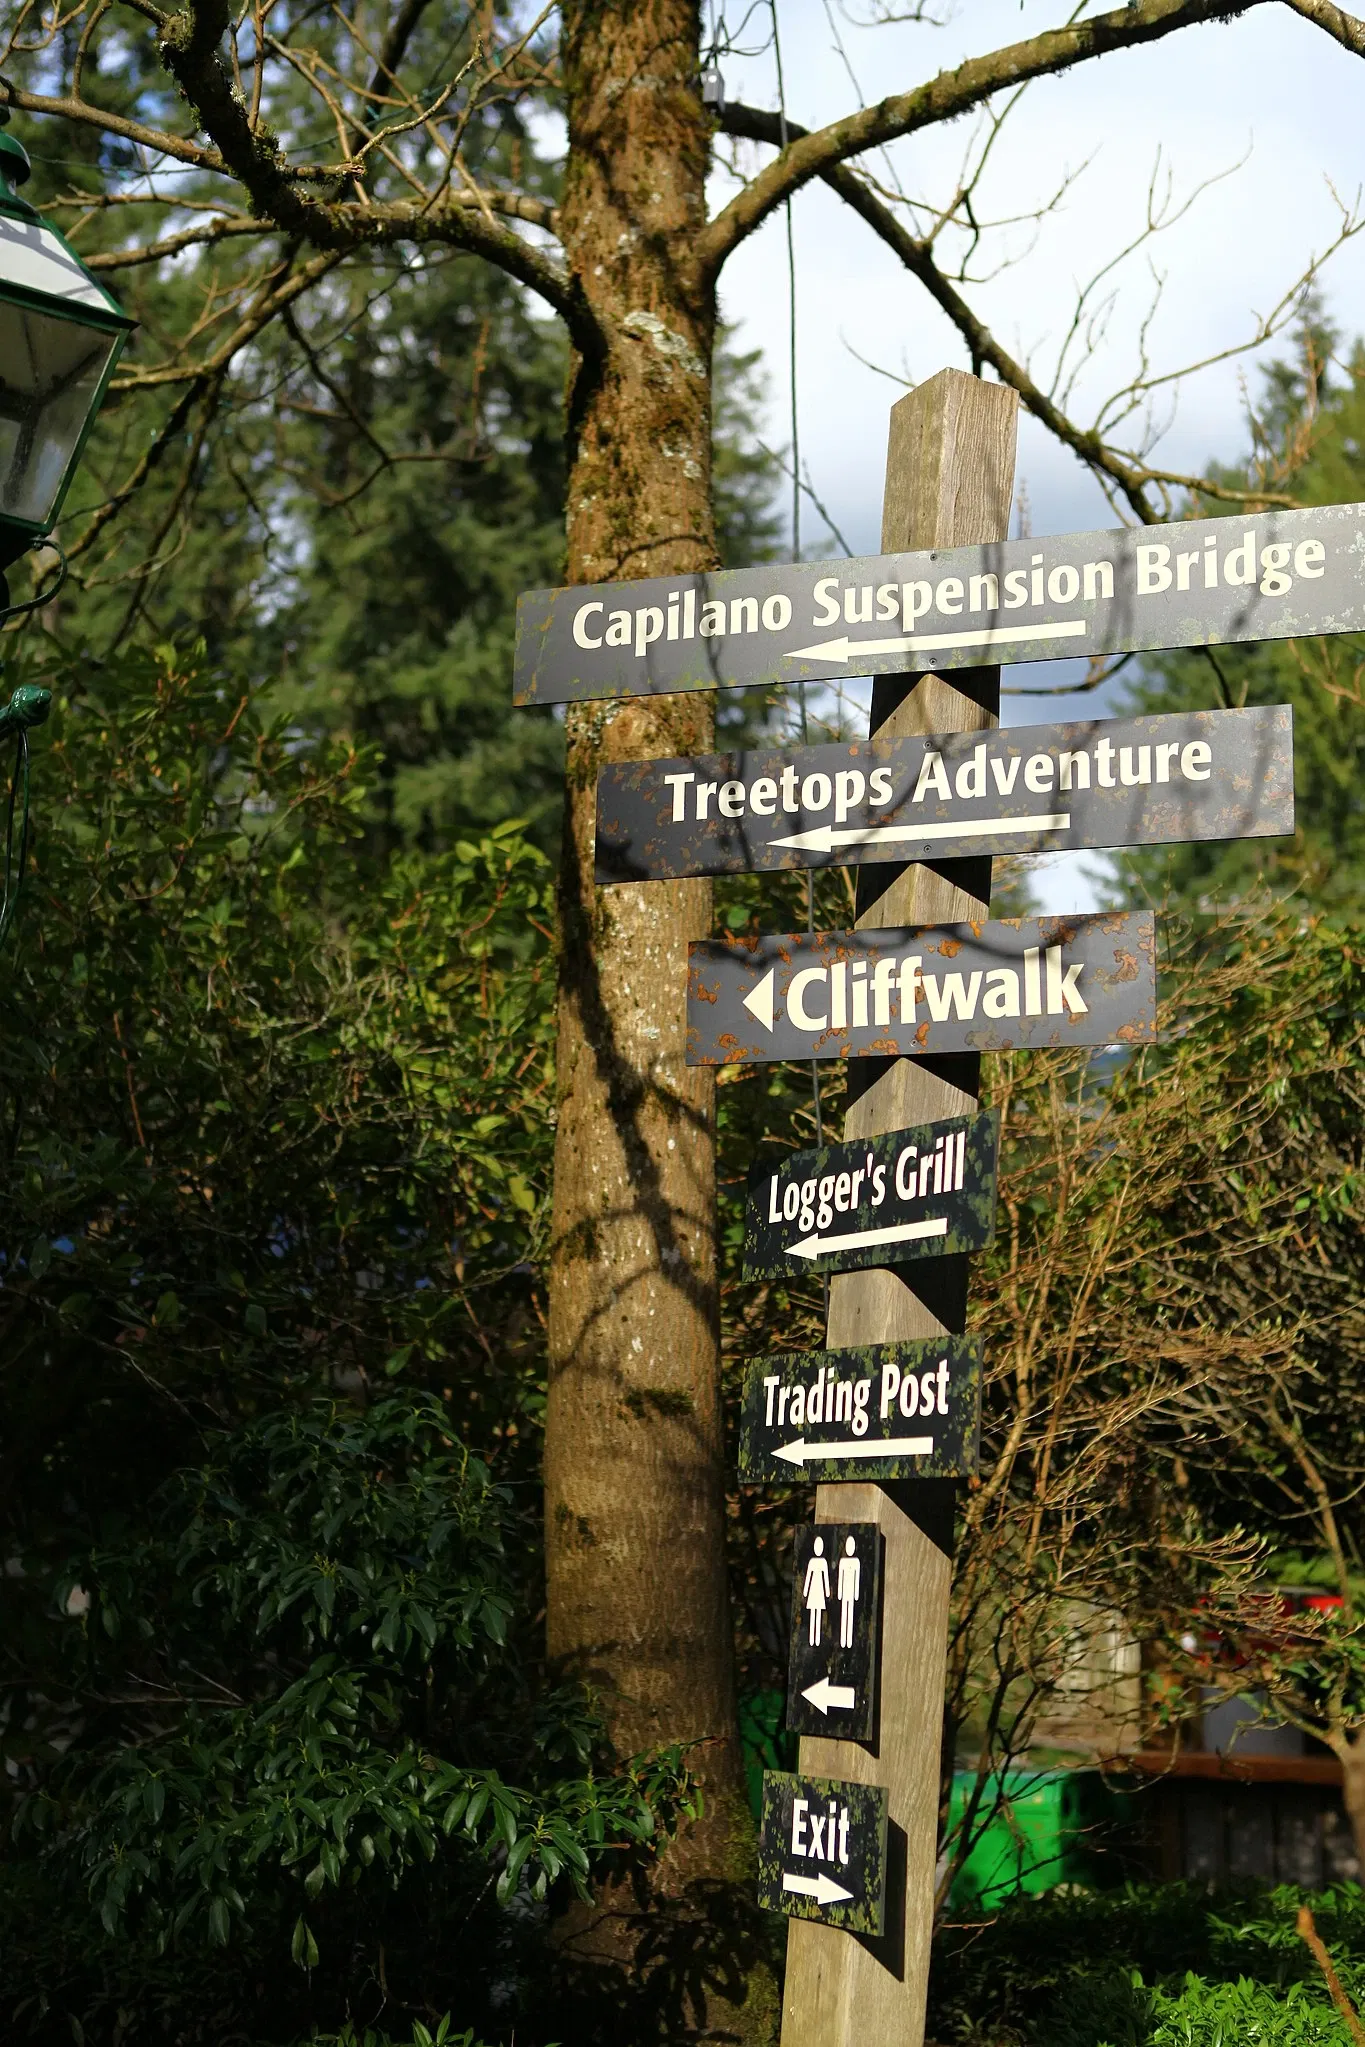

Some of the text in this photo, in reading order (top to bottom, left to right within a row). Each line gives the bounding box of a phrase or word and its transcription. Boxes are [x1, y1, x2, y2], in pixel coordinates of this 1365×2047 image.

[571, 530, 1327, 658] Capilano Suspension Bridge
[663, 736, 1213, 823] Treetops Adventure
[786, 944, 1089, 1033] Cliffwalk
[768, 1131, 966, 1233] Logger's Grill
[763, 1358, 951, 1437] Trading Post
[790, 1798, 851, 1866] Exit
